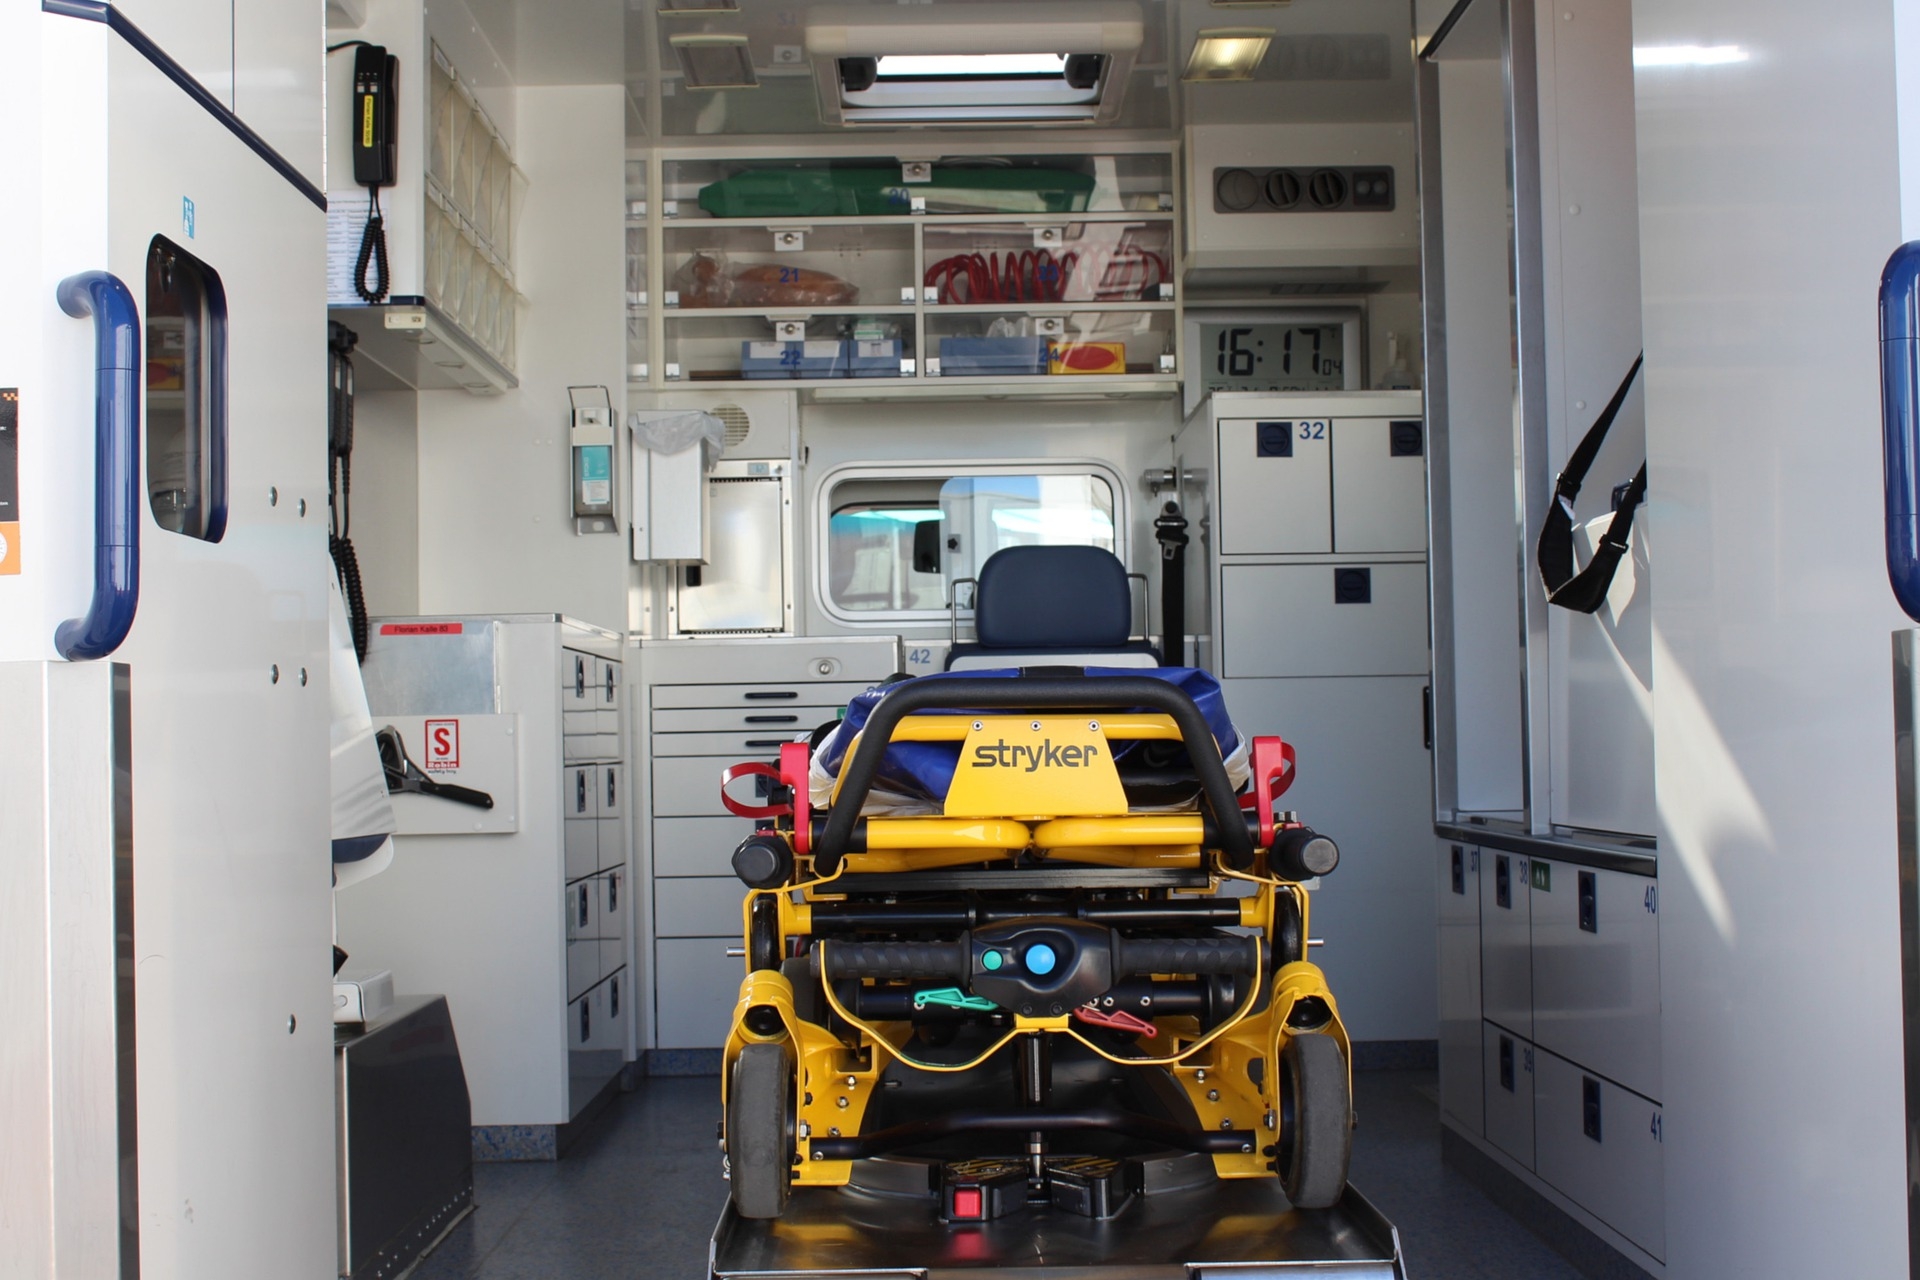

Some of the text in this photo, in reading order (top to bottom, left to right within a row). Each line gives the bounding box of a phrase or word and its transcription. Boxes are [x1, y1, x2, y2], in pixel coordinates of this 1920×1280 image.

[888, 187, 909, 204] 20
[780, 267, 799, 282] 21
[780, 351, 800, 365] 22
[1039, 348, 1060, 362] 24
[1217, 328, 1320, 376] 16:17
[1299, 421, 1325, 440] 32
[394, 625, 418, 633] Florian
[909, 649, 931, 664] 42
[433, 727, 451, 756] S
[972, 739, 1098, 772] stryker
[1470, 850, 1478, 873] 37
[1519, 860, 1528, 884] 38
[1644, 884, 1656, 914] 40
[1523, 1047, 1532, 1073] 39
[1650, 1111, 1662, 1143] 41
